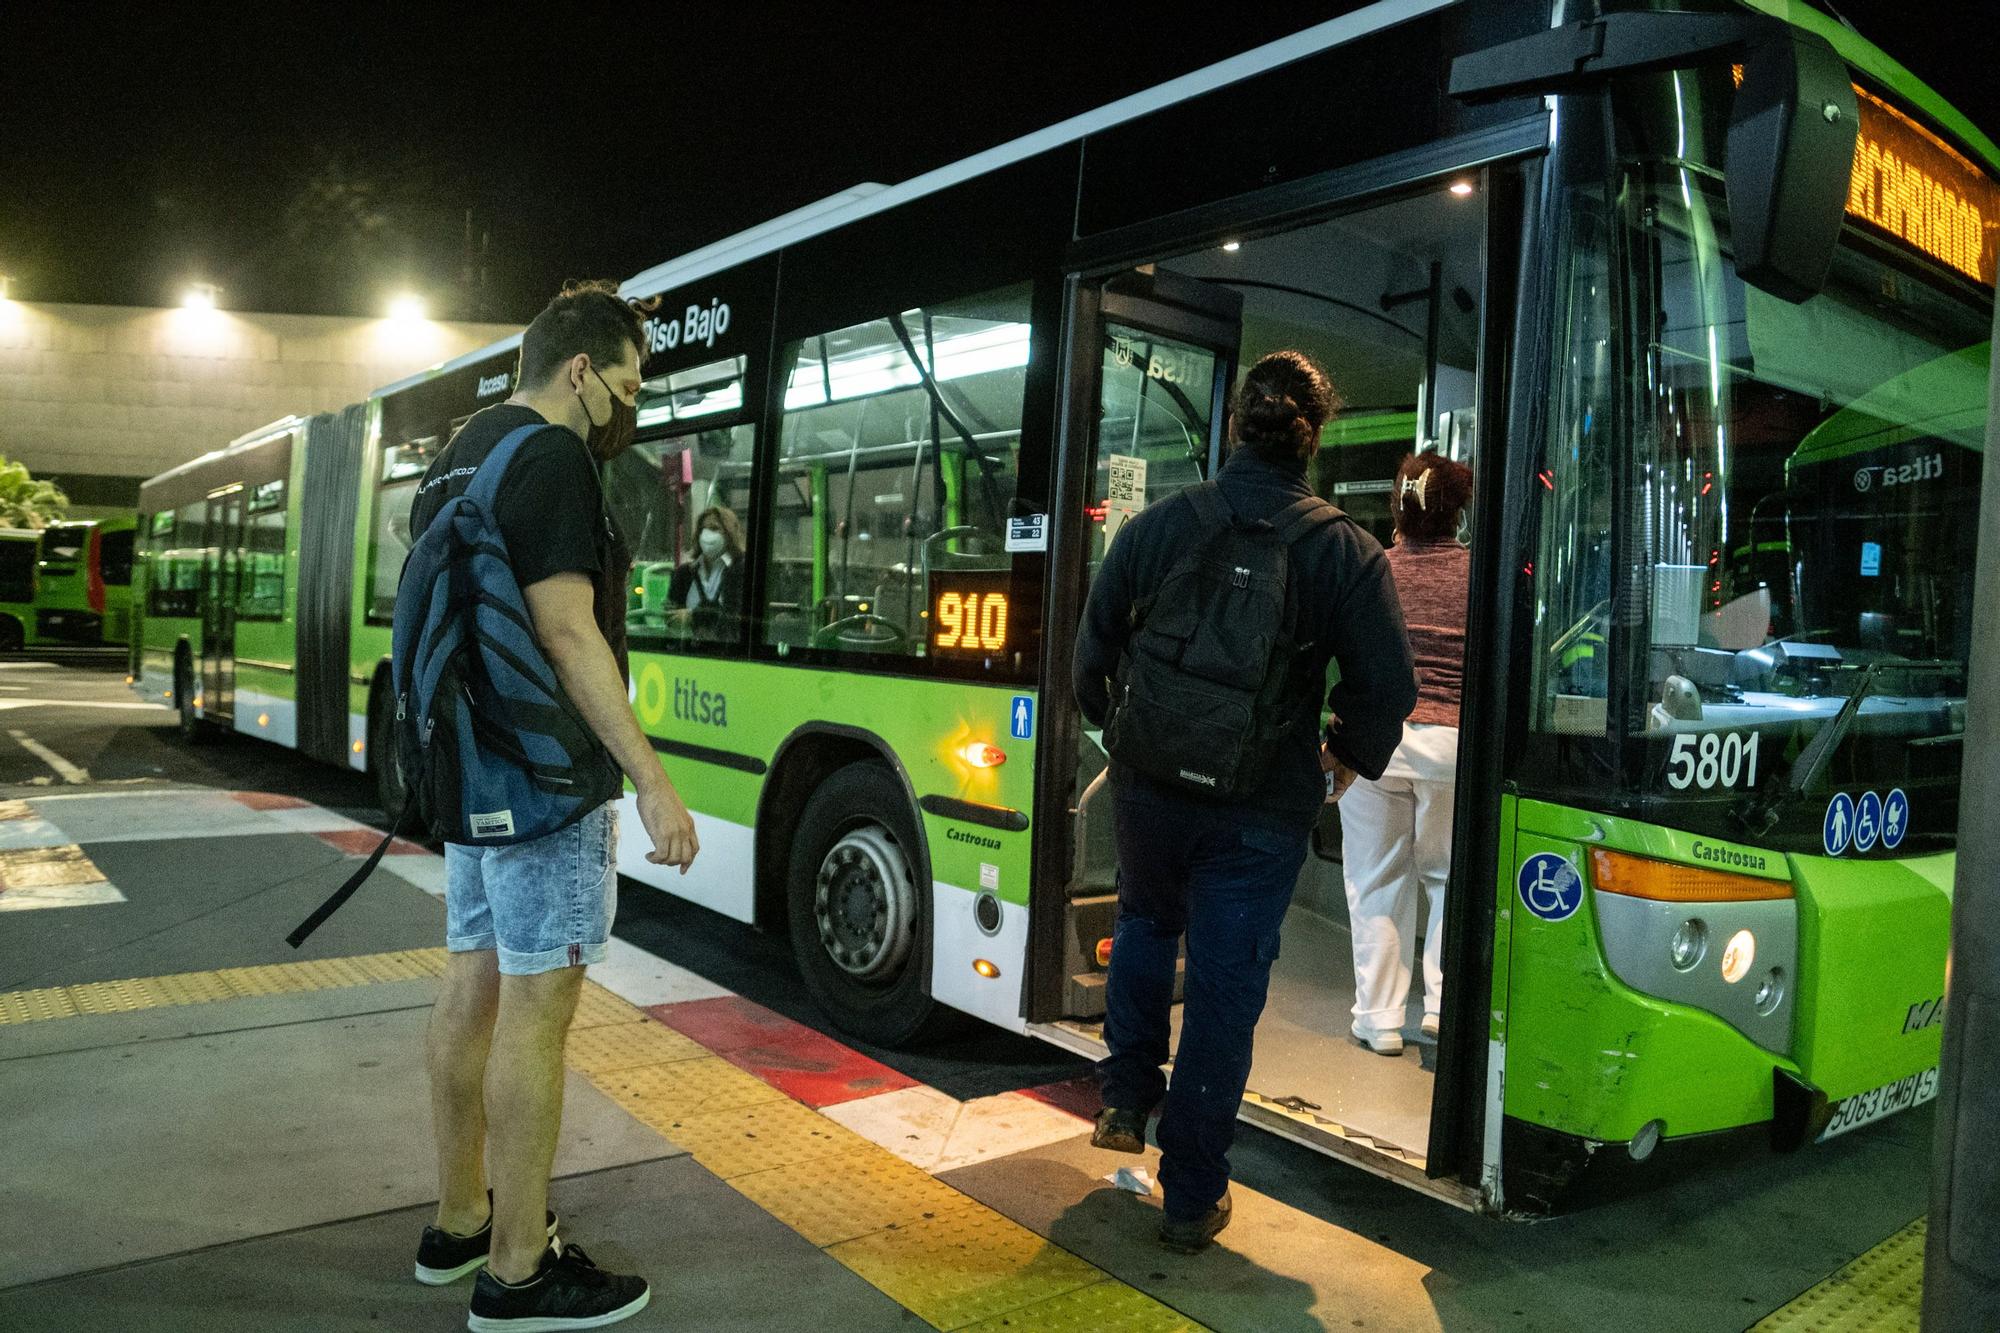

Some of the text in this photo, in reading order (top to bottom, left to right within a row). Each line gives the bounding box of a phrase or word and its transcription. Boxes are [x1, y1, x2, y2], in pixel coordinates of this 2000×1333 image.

[1850, 130, 1982, 283] RCAMBIADOR
[642, 296, 730, 354] Piso Bajo
[477, 372, 509, 398] Acceso
[1031, 528, 1040, 538] 22
[1032, 516, 1042, 525] 43
[937, 592, 1007, 650] 910
[674, 677, 727, 728] titsa
[1667, 731, 1759, 790] 5801
[946, 827, 1002, 850] Castrosua
[1692, 841, 1766, 870] Castrosua
[1902, 995, 1944, 1034] MA
[1830, 1087, 1881, 1131] 5063
